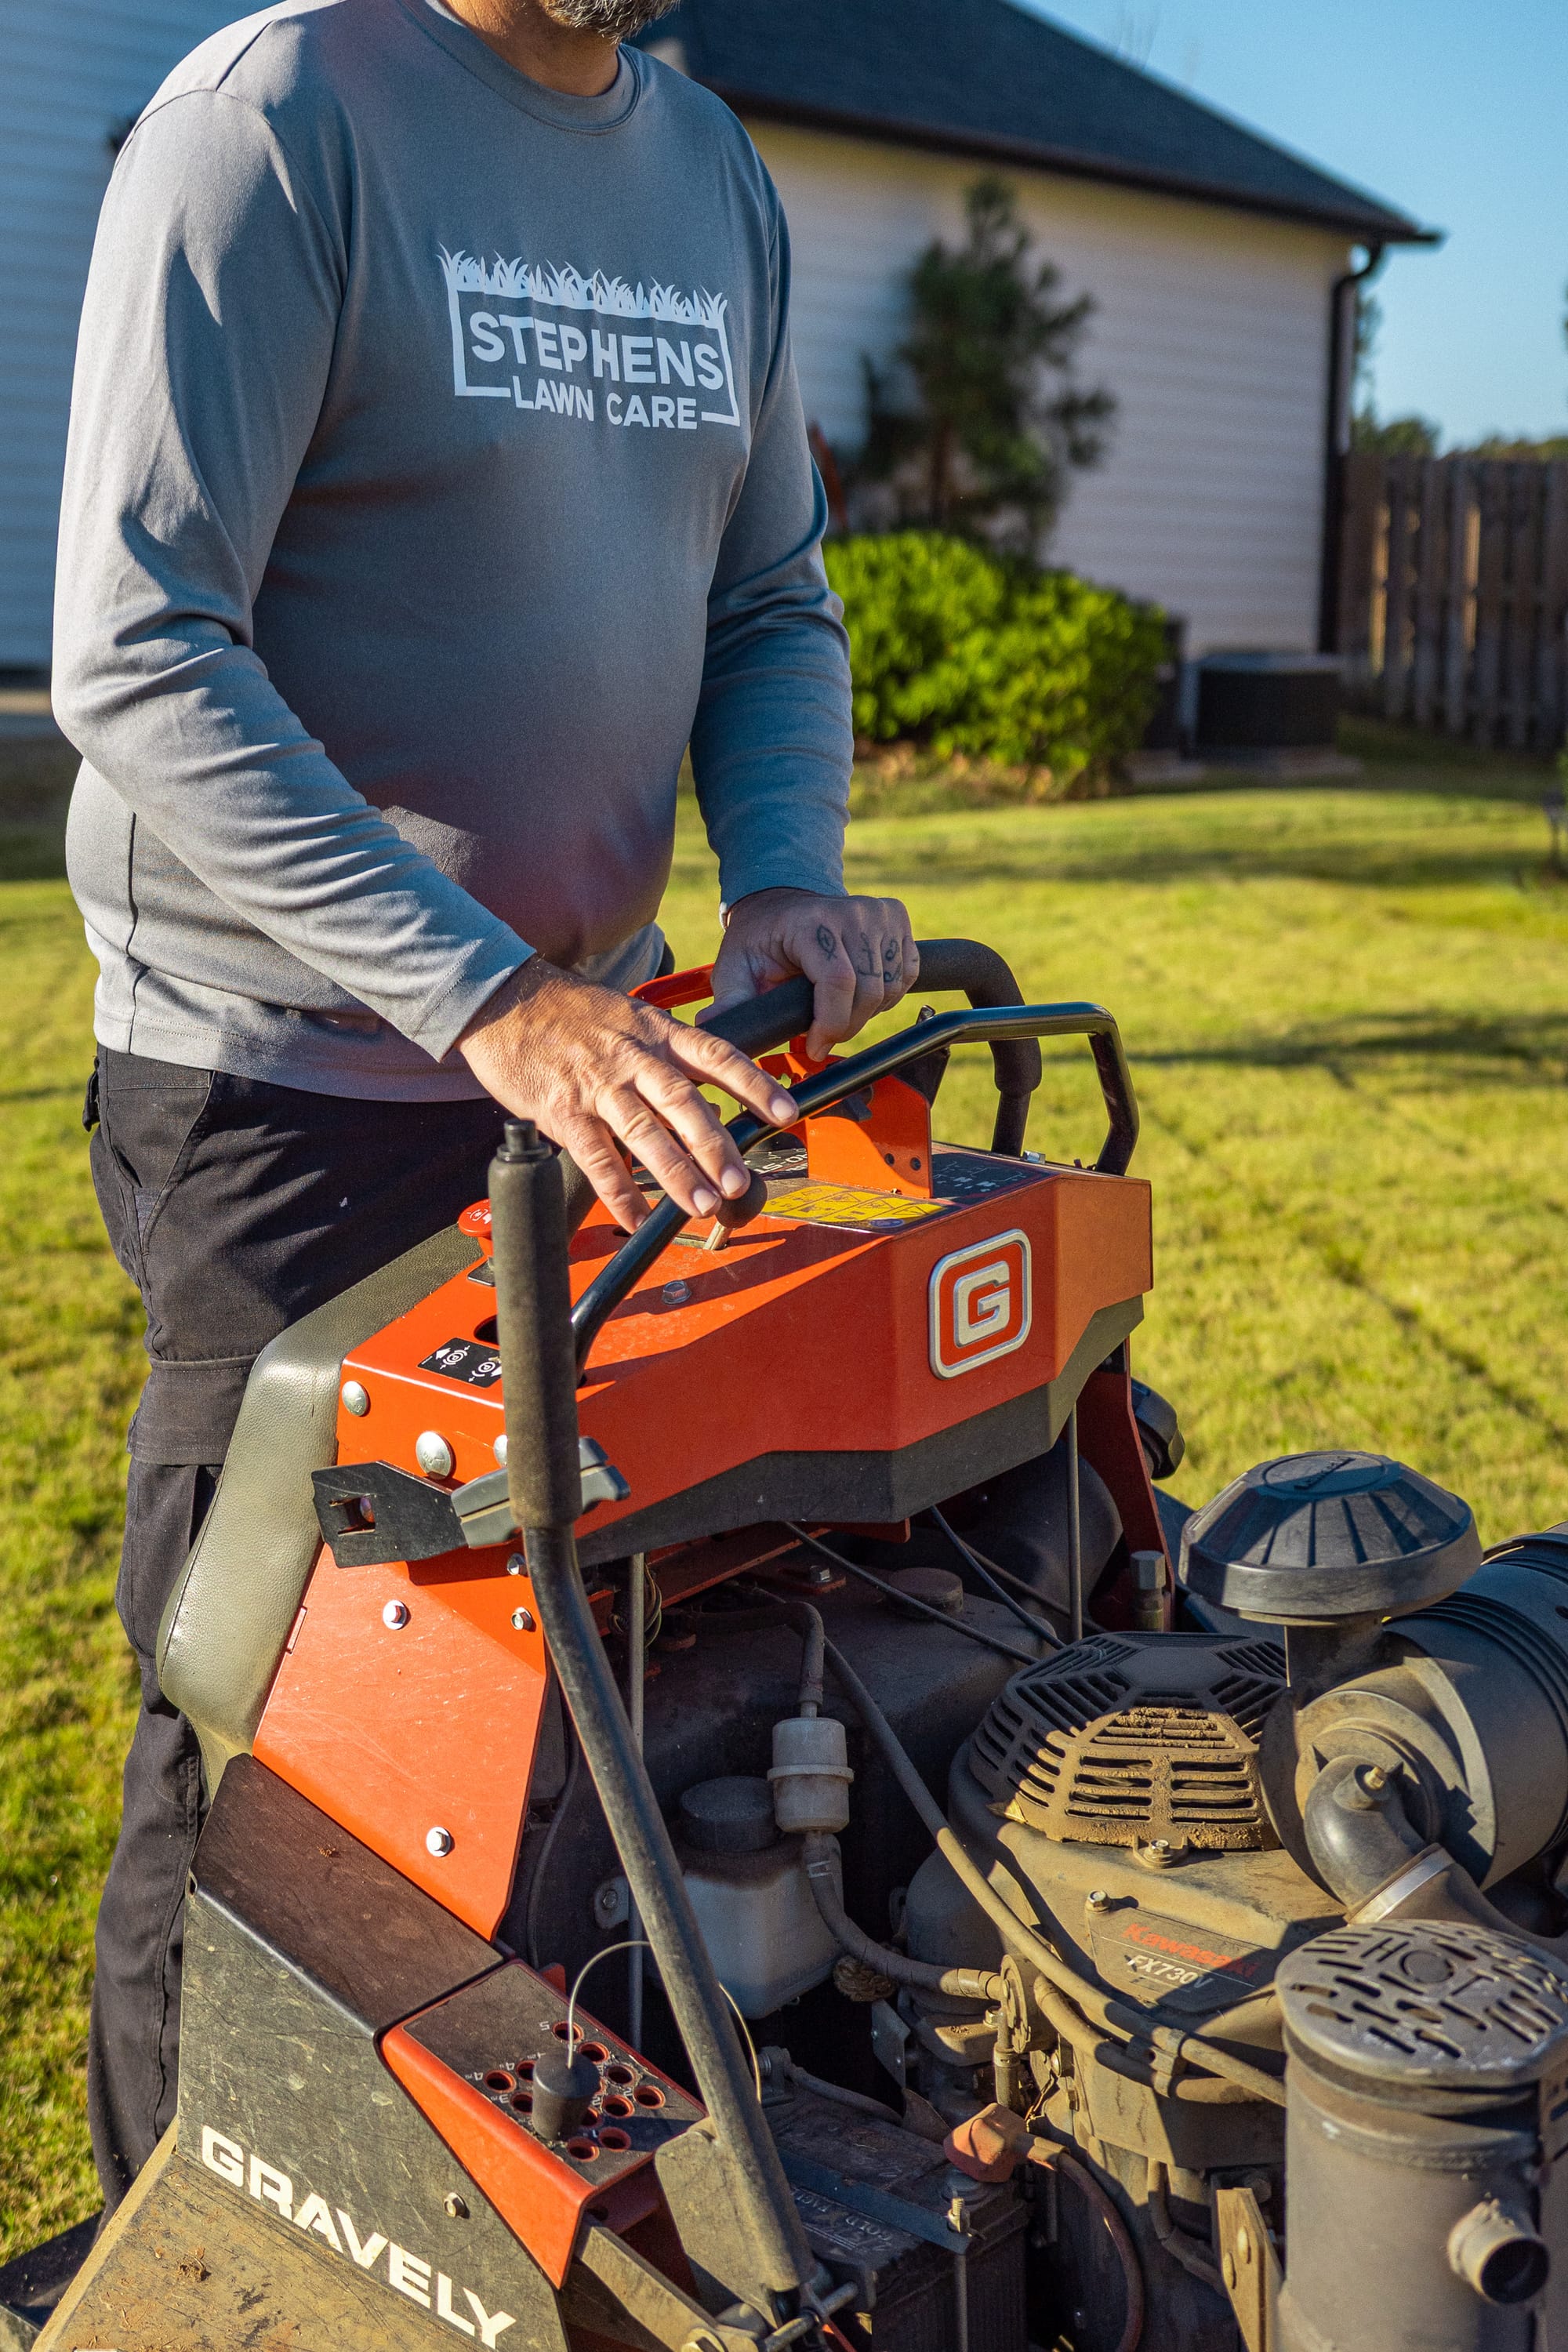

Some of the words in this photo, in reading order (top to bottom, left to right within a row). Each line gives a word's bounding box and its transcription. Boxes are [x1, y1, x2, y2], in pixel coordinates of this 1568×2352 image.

[469, 310, 724, 390] STEPHENS
[512, 376, 594, 422] LAWN
[605, 392, 699, 430] CARE
[953, 1260, 1011, 1349] G
[1127, 1954, 1214, 1990] FX730V
[201, 2125, 517, 2350] GRAVELY
